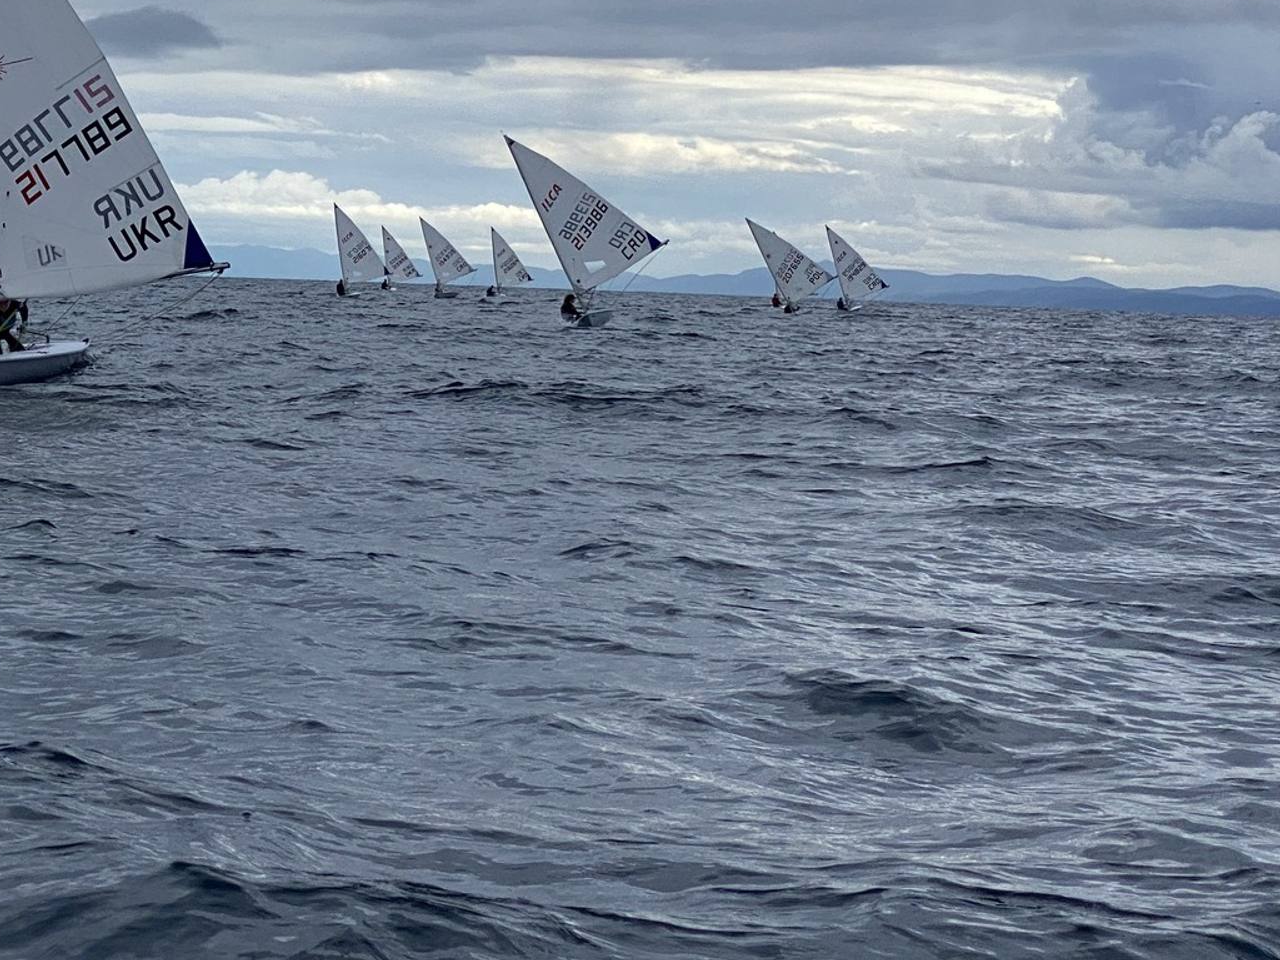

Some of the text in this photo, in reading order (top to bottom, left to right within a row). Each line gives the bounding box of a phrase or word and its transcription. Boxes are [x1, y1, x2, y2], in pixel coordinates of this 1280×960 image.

[15, 105, 133, 206] 217789
[541, 184, 562, 213] ILCA
[107, 204, 184, 262] UKR
[570, 200, 609, 251] 213986
[621, 230, 647, 261] CRO
[809, 270, 825, 285] POL
